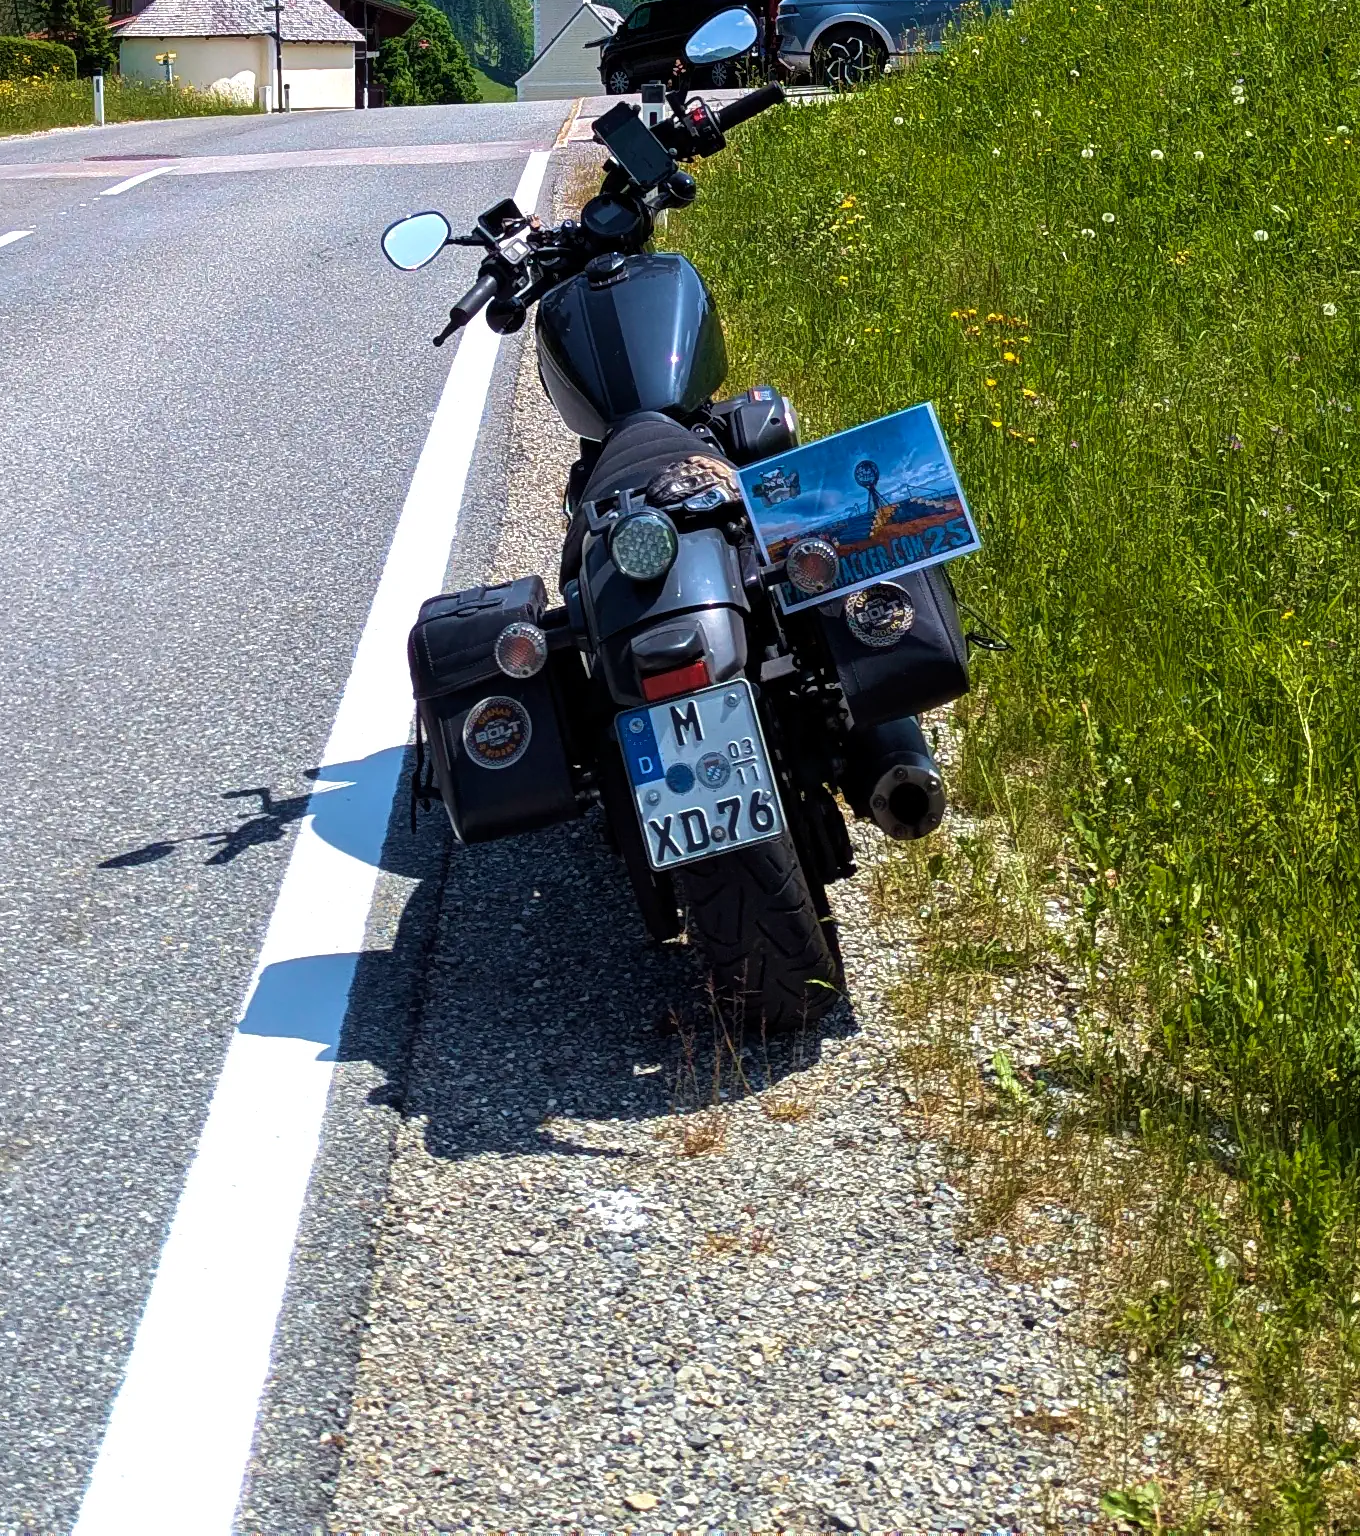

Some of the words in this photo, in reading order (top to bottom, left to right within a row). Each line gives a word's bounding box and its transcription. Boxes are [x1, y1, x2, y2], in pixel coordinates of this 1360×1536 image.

[924, 516, 971, 555] 25
[856, 599, 900, 624] BOLT
[475, 720, 521, 743] BOLT
[669, 700, 705, 746] M
[727, 737, 754, 759] 03
[638, 756, 654, 775] D
[736, 763, 761, 785] 11
